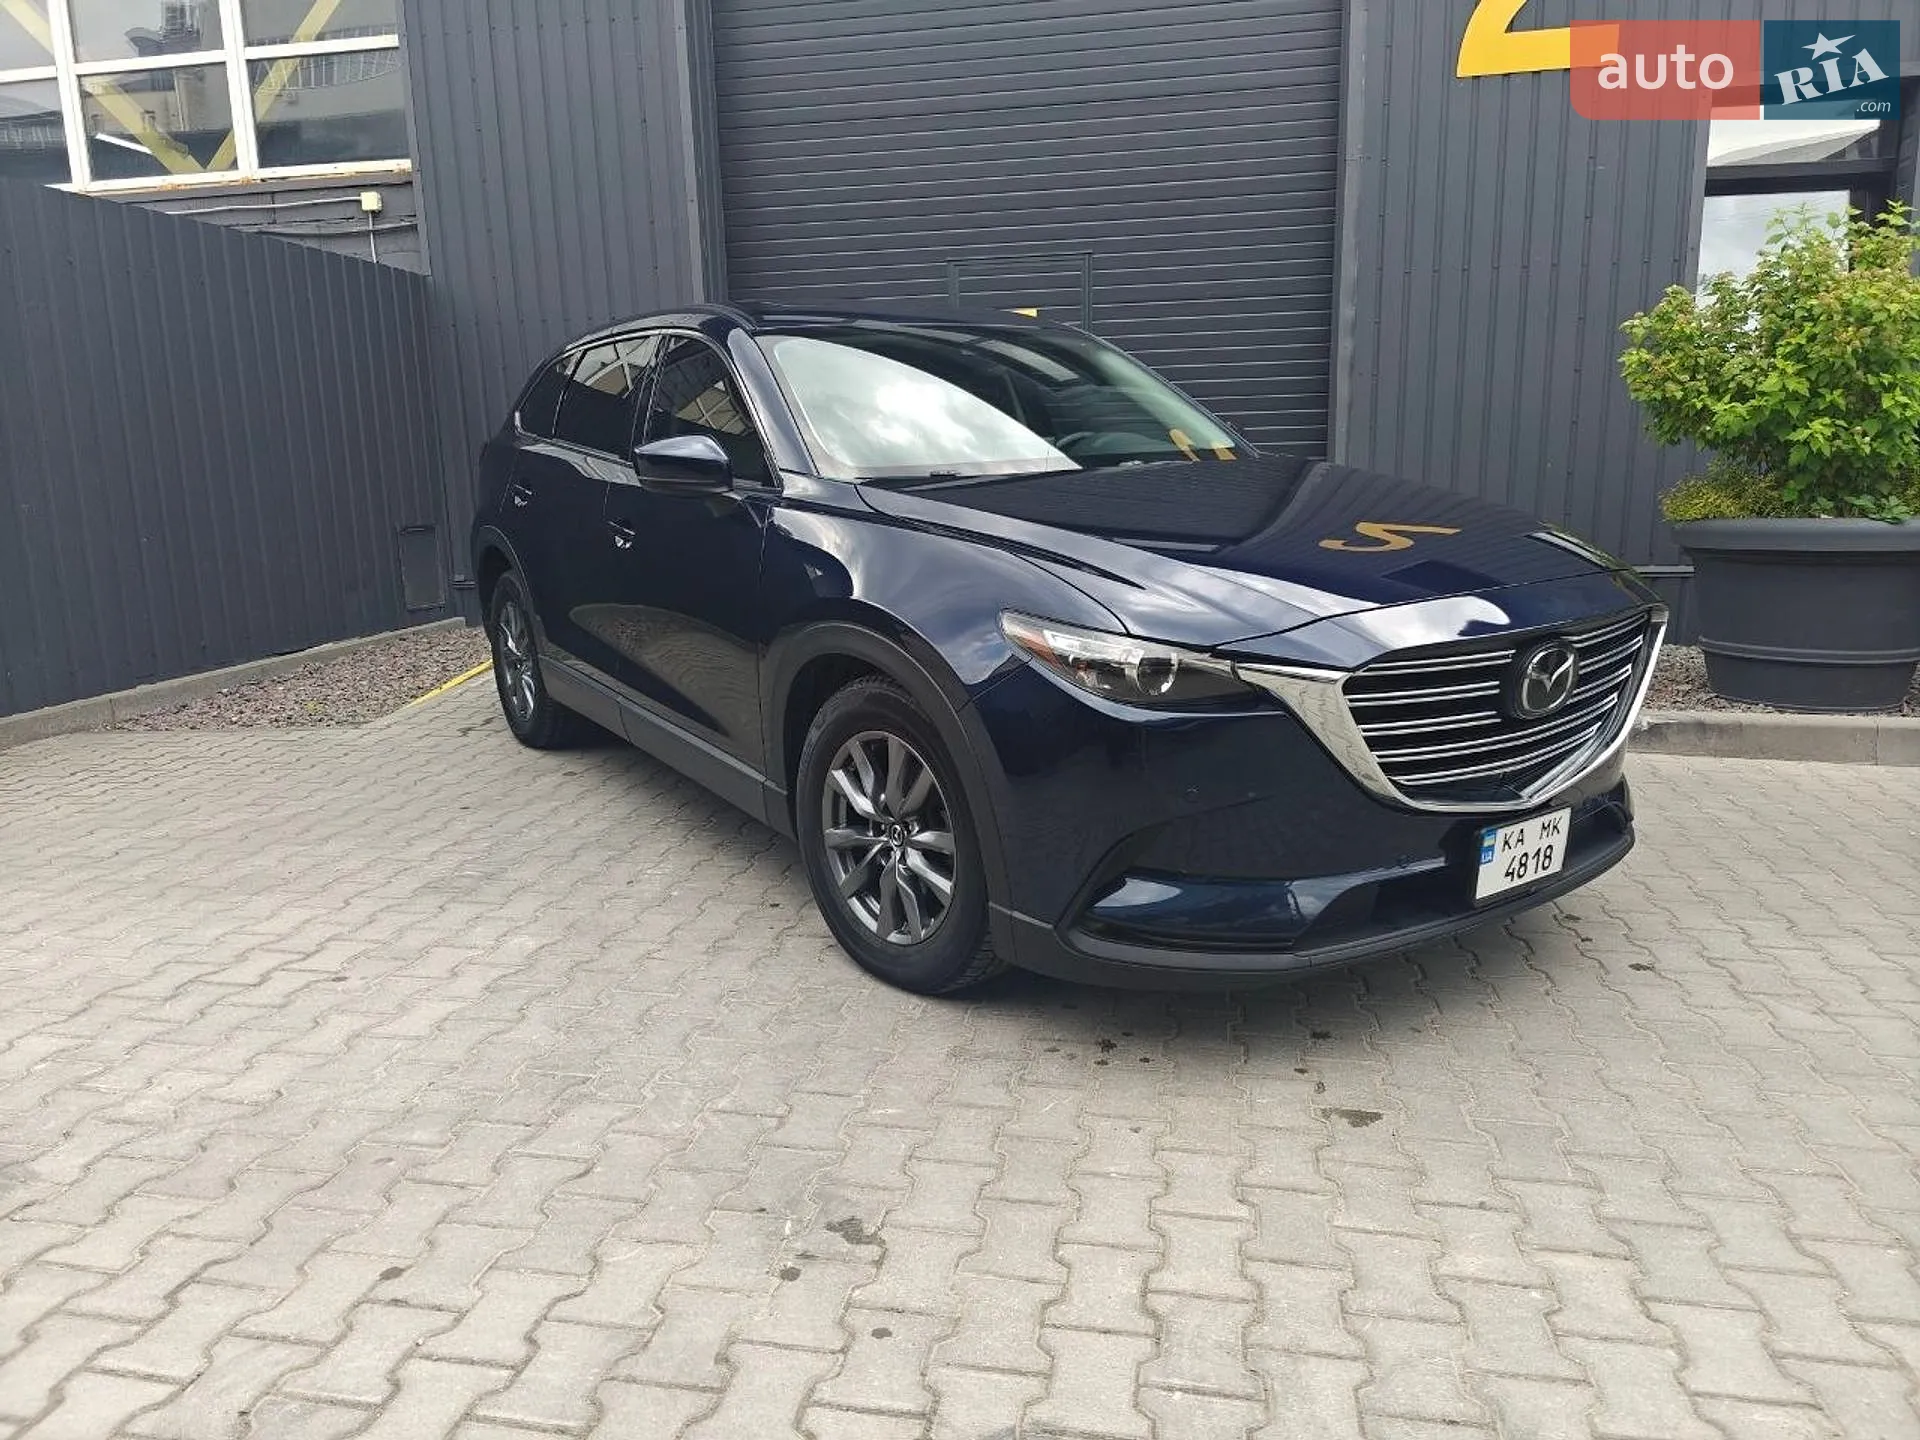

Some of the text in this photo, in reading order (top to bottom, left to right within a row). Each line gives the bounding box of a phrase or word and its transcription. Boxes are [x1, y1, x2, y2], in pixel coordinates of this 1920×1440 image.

[1502, 816, 1563, 852] KA MK
[1504, 844, 1554, 882] 4818
